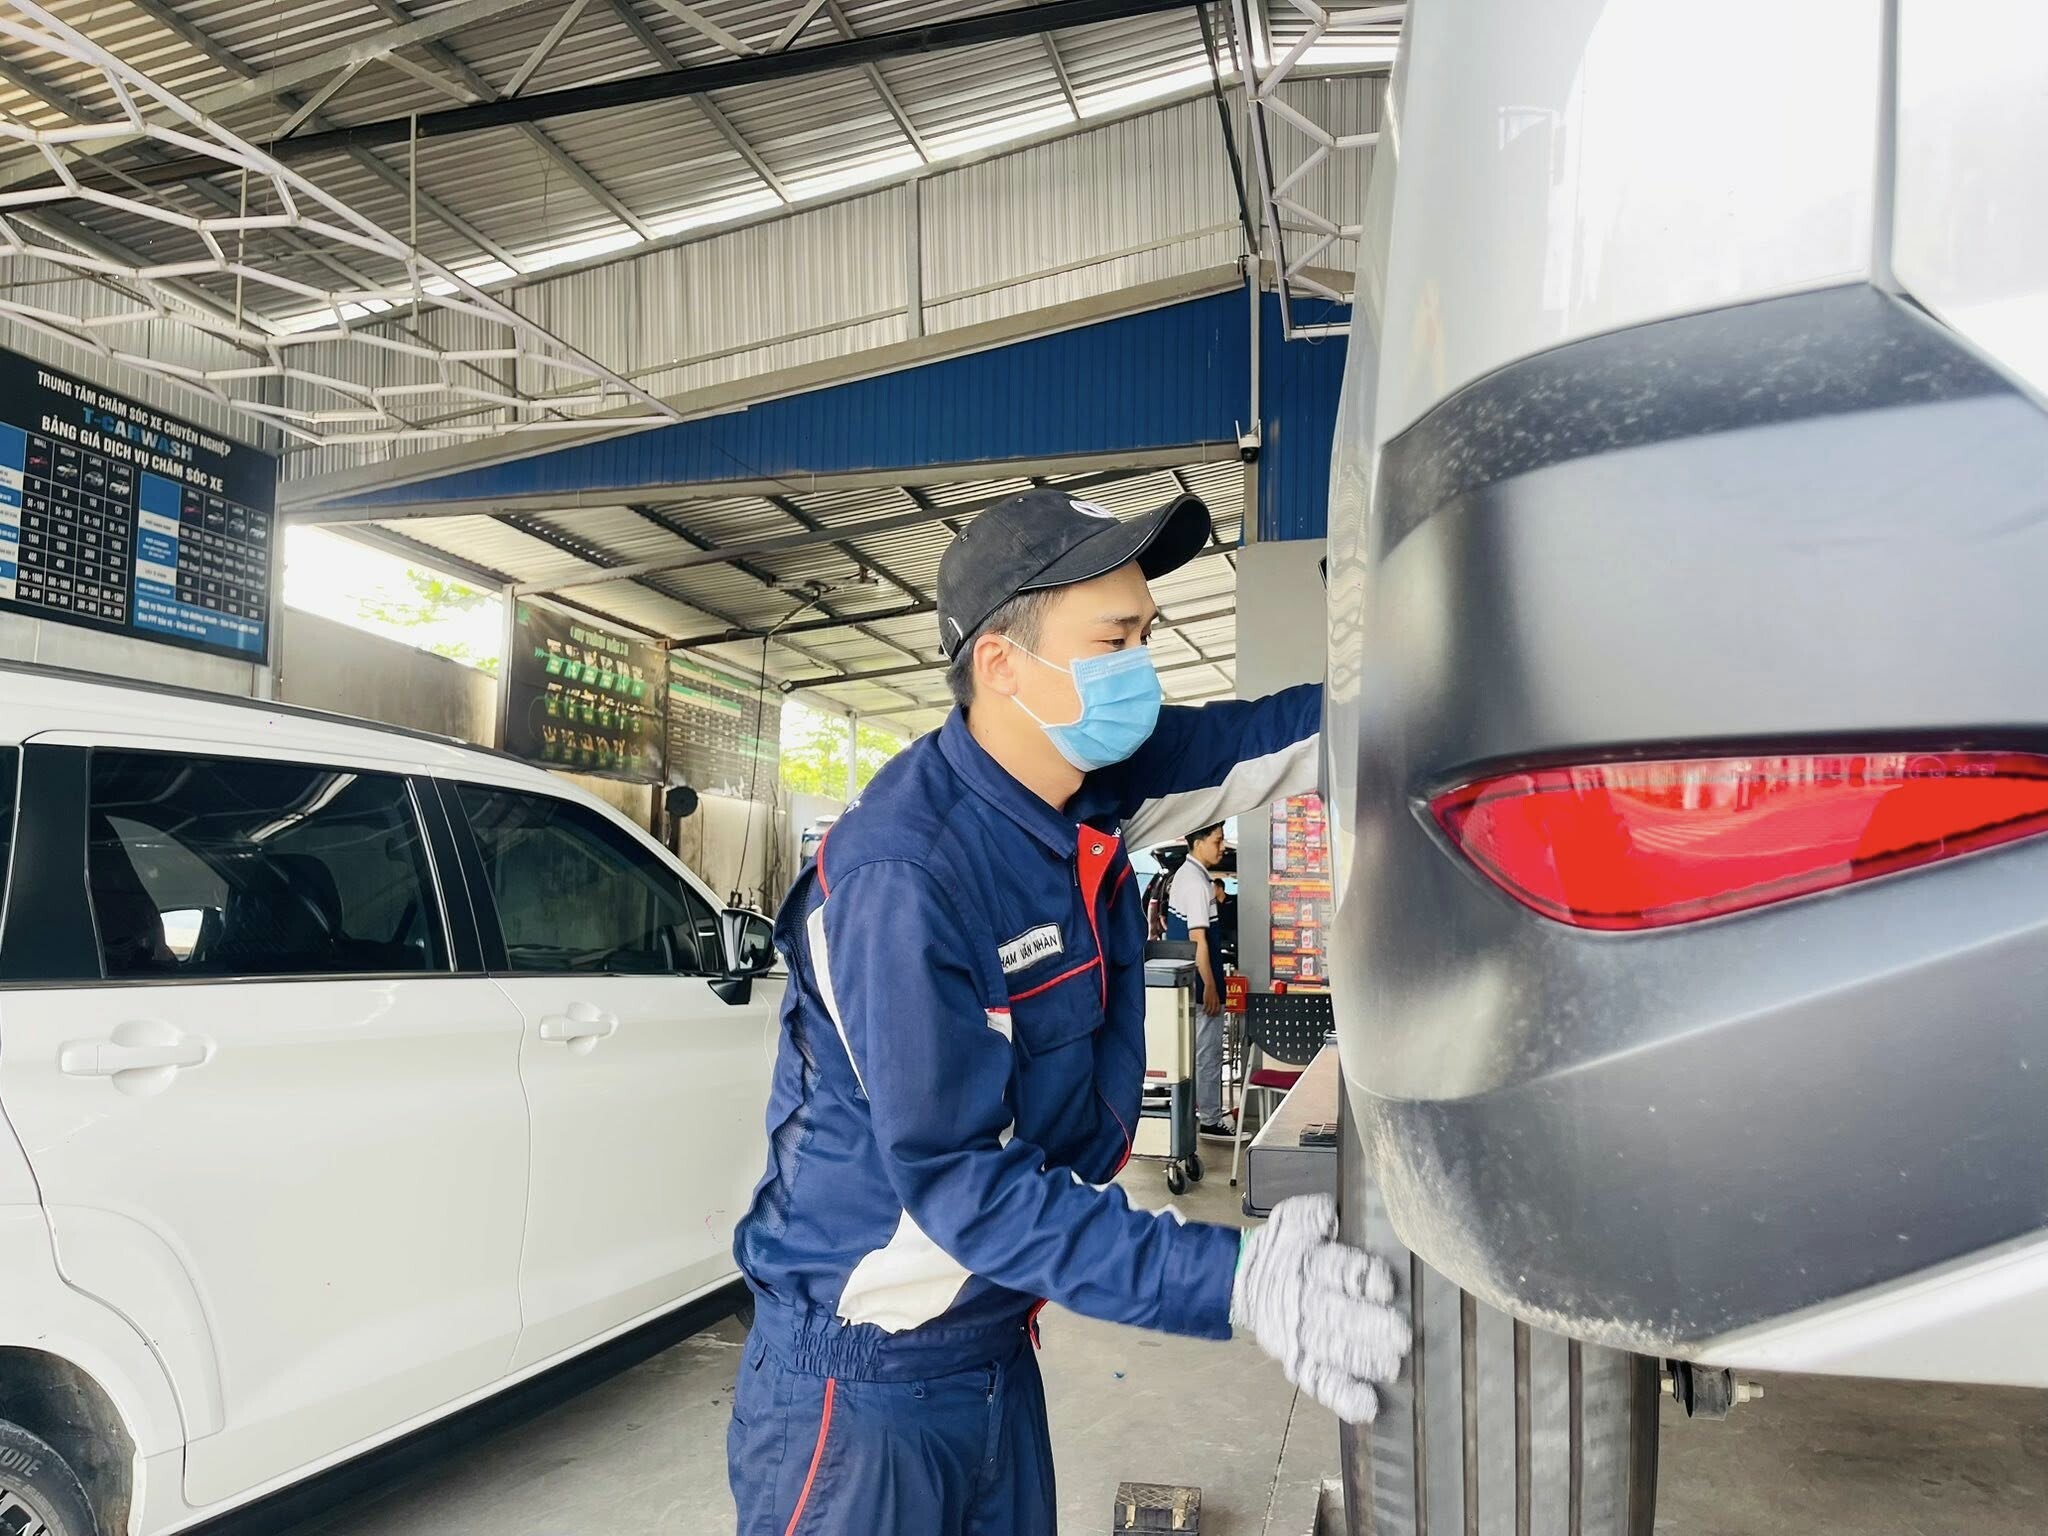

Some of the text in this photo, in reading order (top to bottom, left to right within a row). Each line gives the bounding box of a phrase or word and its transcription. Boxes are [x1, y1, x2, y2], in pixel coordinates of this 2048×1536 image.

[38, 371, 72, 396] TRUNG
[74, 384, 96, 406] TÂM
[98, 395, 127, 417] CHĂM
[129, 407, 148, 425] SÓC
[150, 415, 162, 431] XE
[42, 414, 223, 492] BẢNG GIÁ DỊCH VỤ CHĂM SÓC XE
